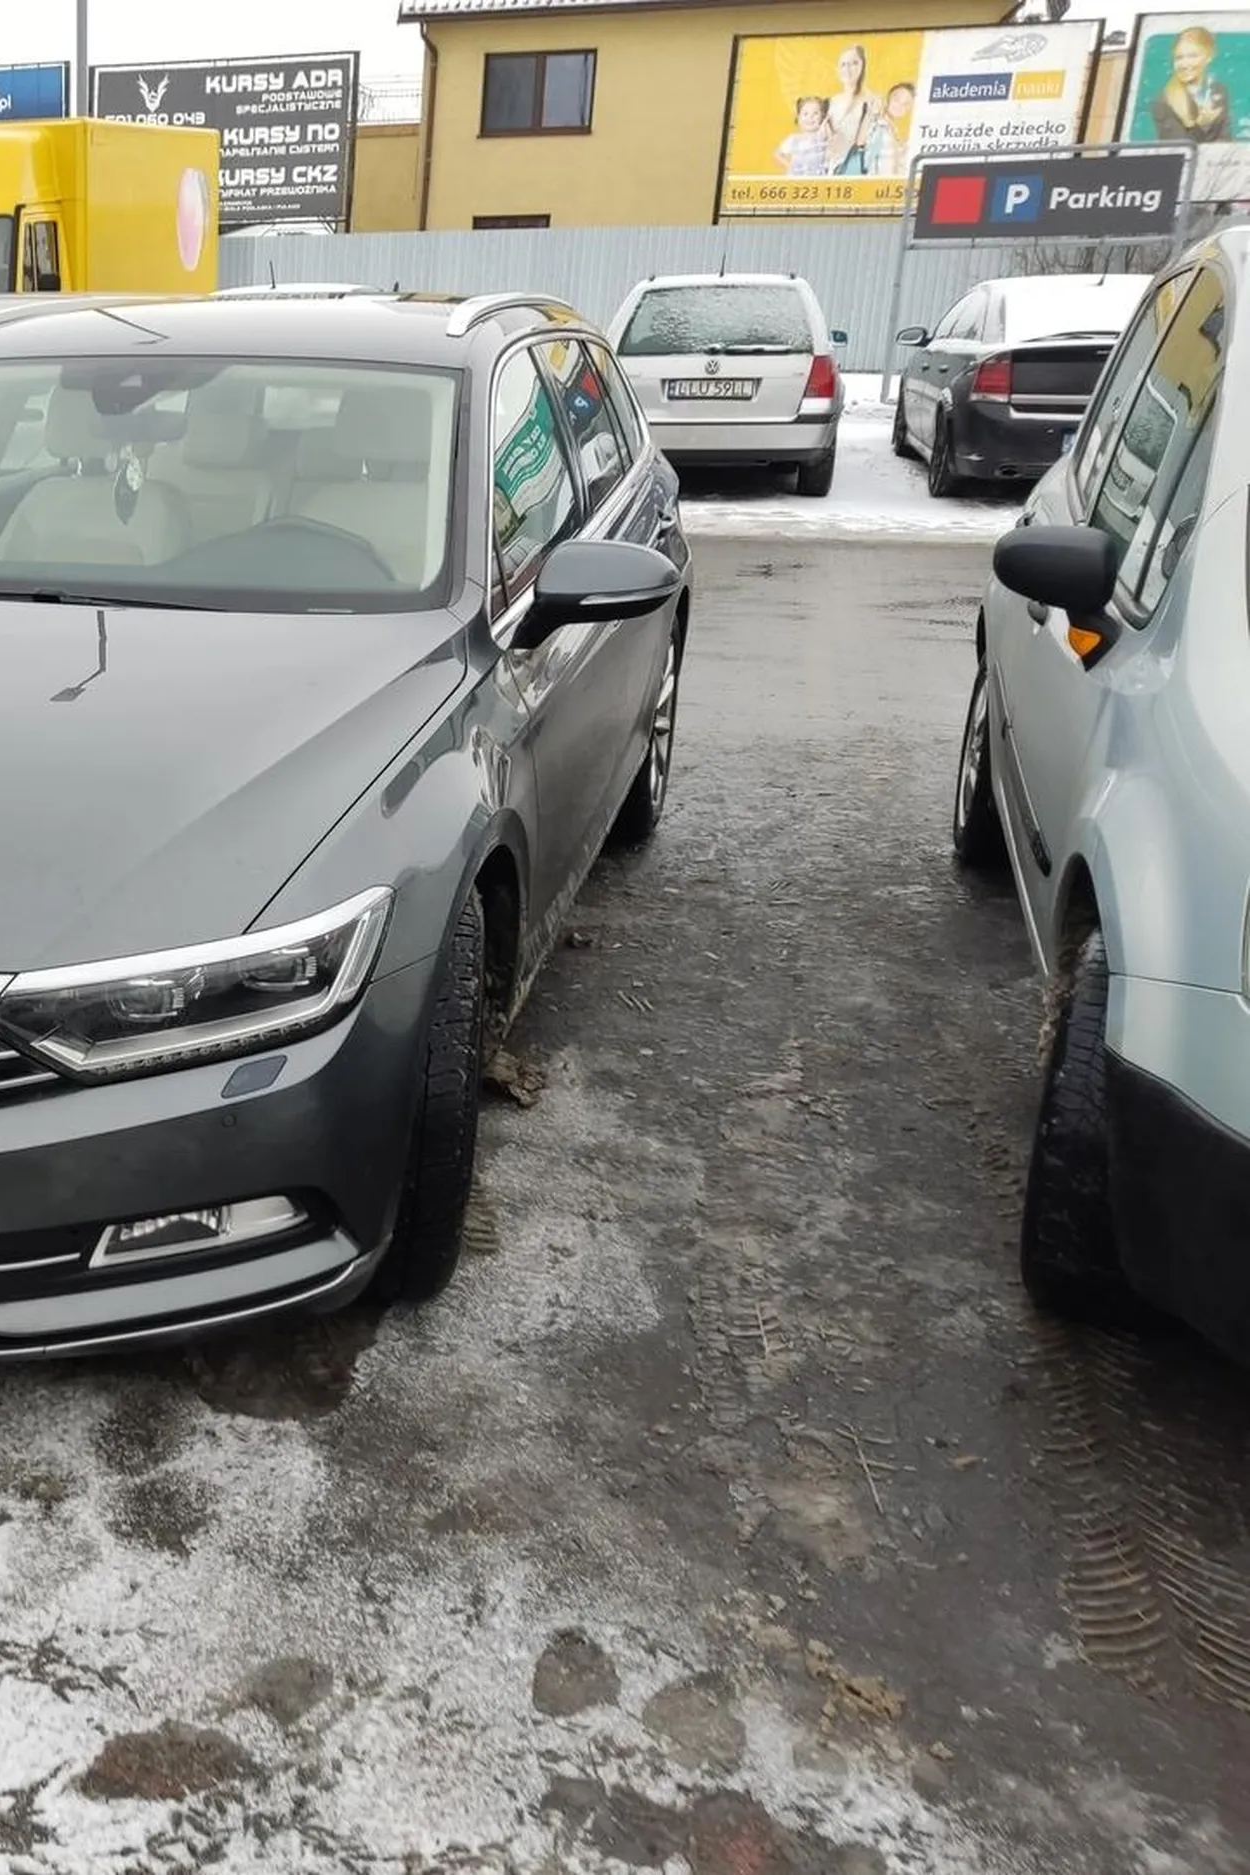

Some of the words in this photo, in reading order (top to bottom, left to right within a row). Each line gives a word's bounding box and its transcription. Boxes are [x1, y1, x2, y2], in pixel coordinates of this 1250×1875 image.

[206, 72, 284, 94] KURSY
[292, 69, 342, 89] ADR
[932, 81, 1007, 98] akademia
[262, 89, 342, 102] PODSTAWOWE
[236, 100, 341, 114] SPECJALISTYCZNE
[173, 111, 205, 125] 043
[224, 125, 300, 145] KURSY
[920, 124, 939, 138] Tu
[944, 123, 994, 138] każde
[1000, 120, 1066, 136] dziecko
[292, 164, 338, 183] CKZ
[731, 186, 754, 199] tel.
[759, 187, 787, 199] 666
[792, 187, 818, 199] 323
[827, 186, 853, 199] 118
[1005, 184, 1030, 214] P
[1050, 186, 1162, 212] Parking
